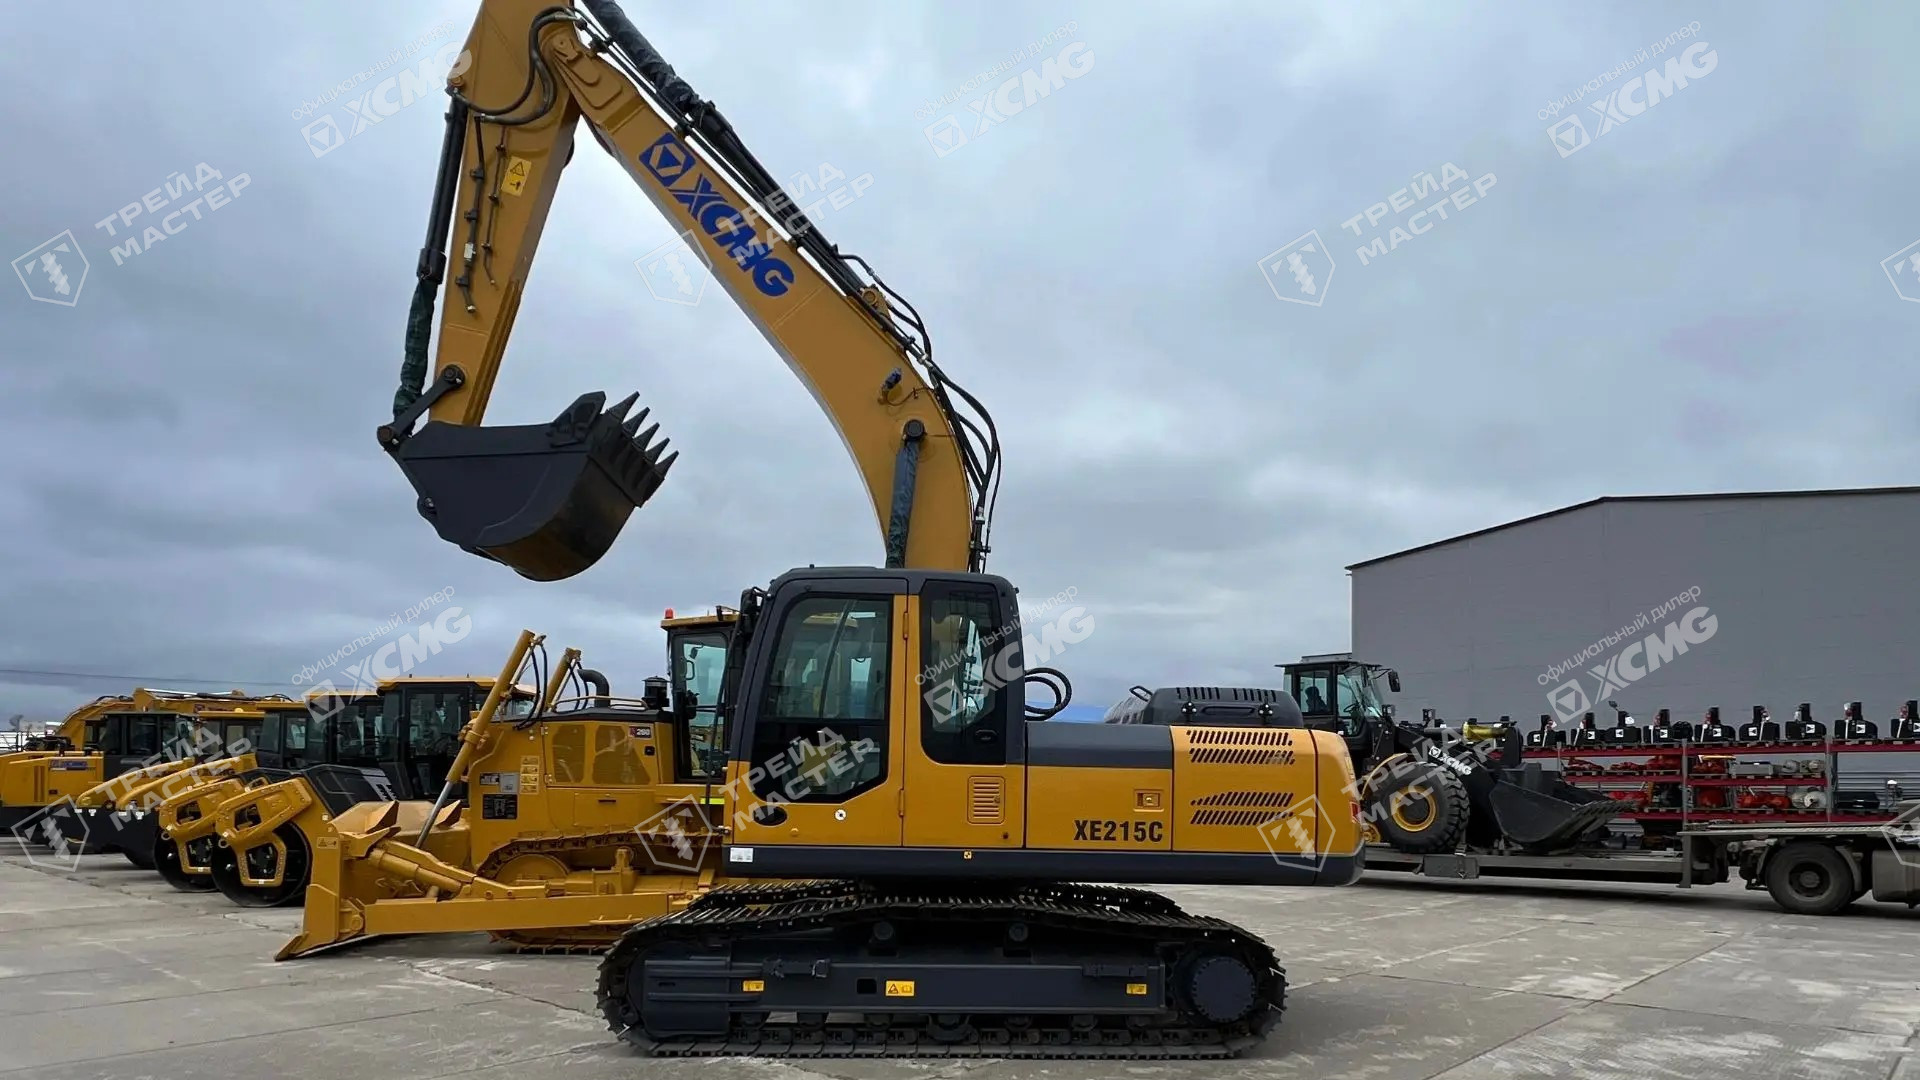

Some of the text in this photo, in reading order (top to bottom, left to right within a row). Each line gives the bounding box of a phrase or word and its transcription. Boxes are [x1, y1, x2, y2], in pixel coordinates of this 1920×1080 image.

[668, 171, 795, 297] XCMG
[1438, 753, 1472, 775] XCMG
[1073, 819, 1163, 842] XE215C
